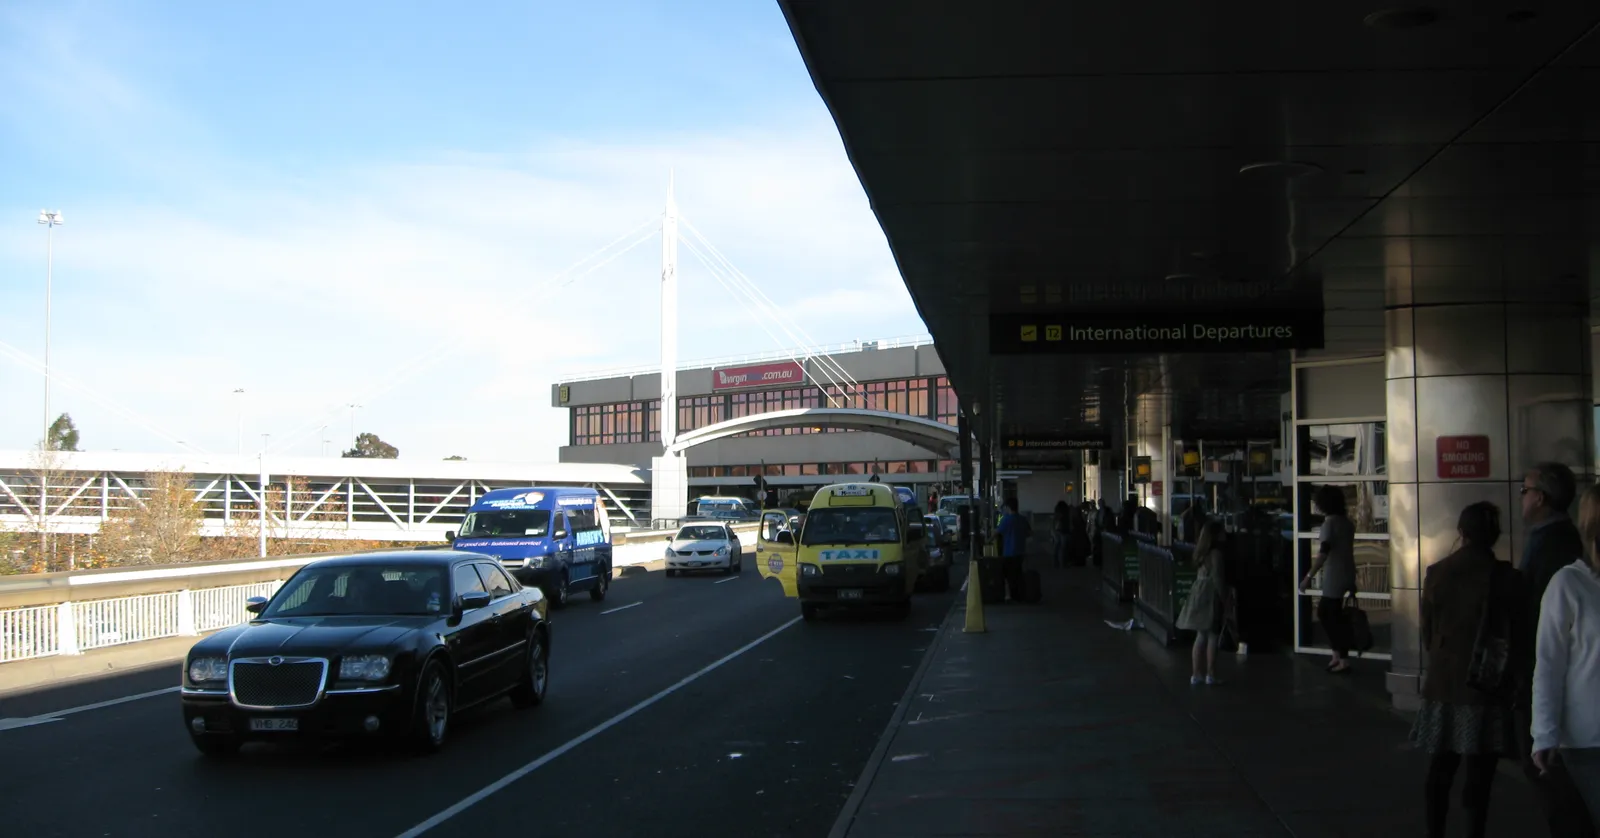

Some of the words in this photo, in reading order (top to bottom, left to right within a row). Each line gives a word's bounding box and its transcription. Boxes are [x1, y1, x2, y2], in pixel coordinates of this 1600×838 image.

[1070, 323, 1187, 341] International
[1193, 323, 1293, 344] Departures
[726, 369, 792, 385] virgin.com.au
[1025, 439, 1067, 447] International
[1456, 439, 1470, 450] NO
[1442, 452, 1485, 463] SMOKING
[1451, 464, 1476, 475] AREA
[821, 550, 878, 560] TAXI
